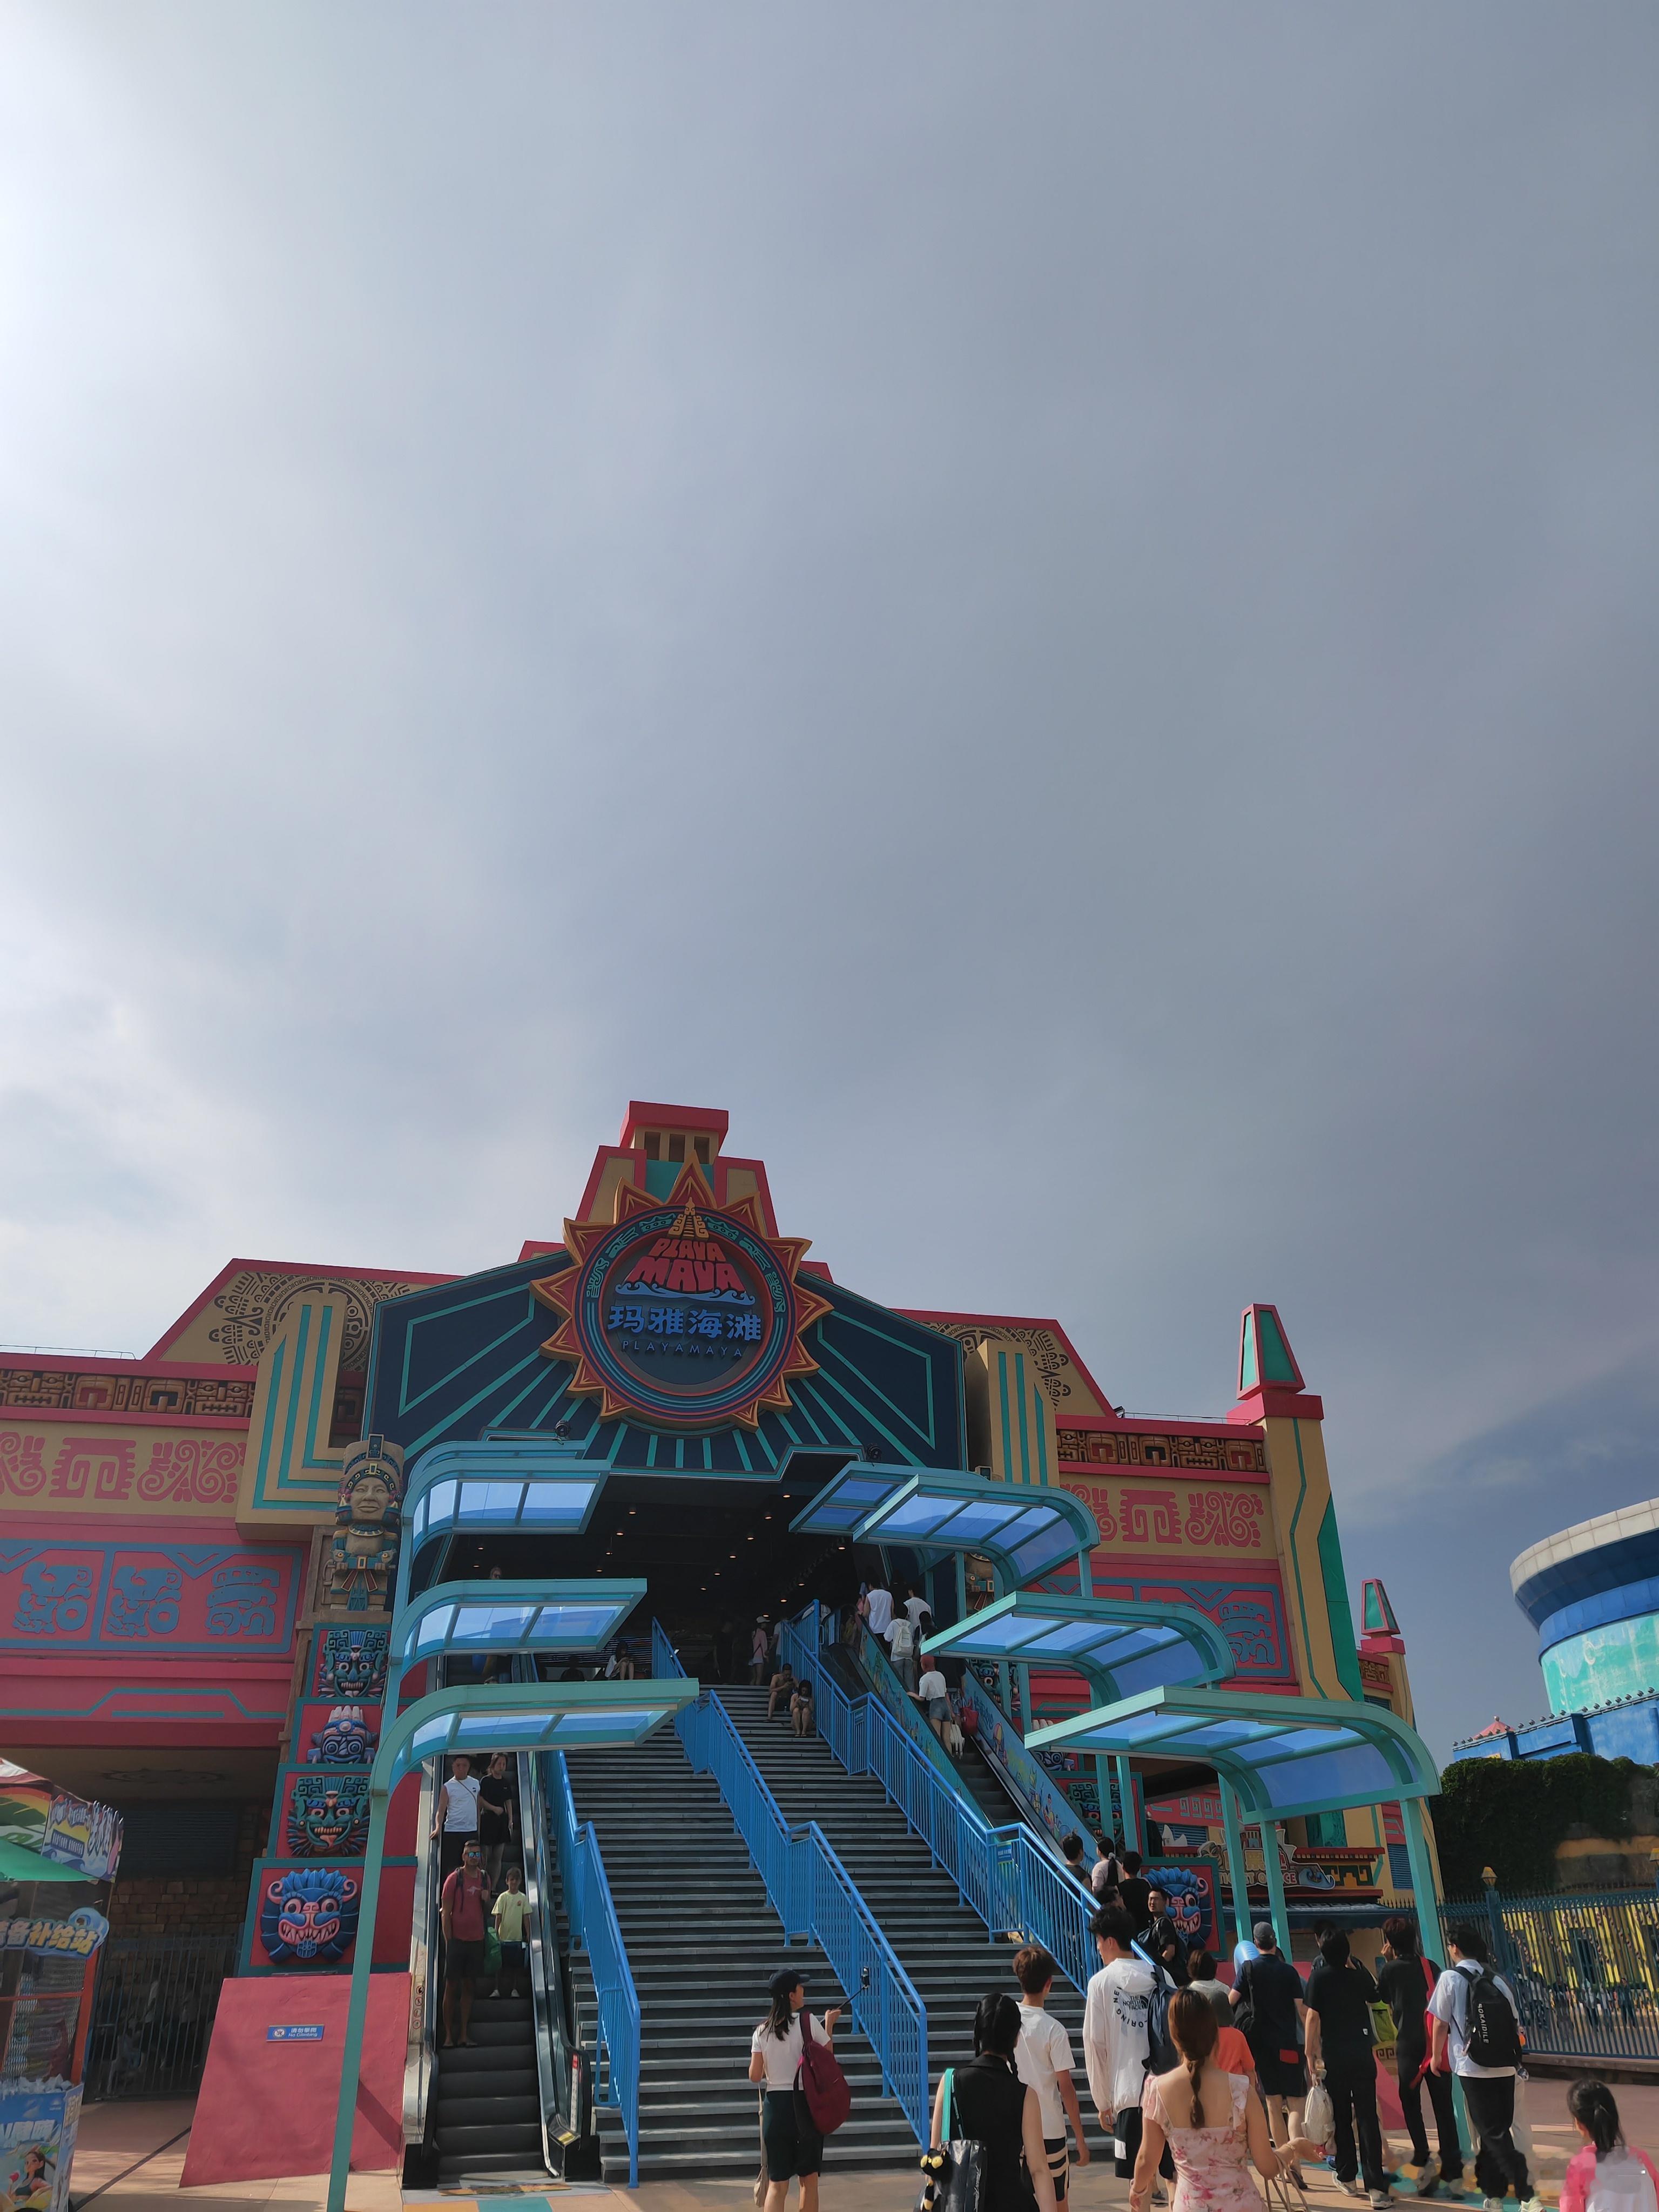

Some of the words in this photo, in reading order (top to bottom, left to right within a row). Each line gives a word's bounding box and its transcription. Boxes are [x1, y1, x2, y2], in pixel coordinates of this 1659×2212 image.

[648, 1238, 726, 1262] PLAYA
[625, 1257, 746, 1292] MAYA
[608, 1305, 761, 1340] 玛雅海滩
[623, 1340, 742, 1357] PLAYAMAYA
